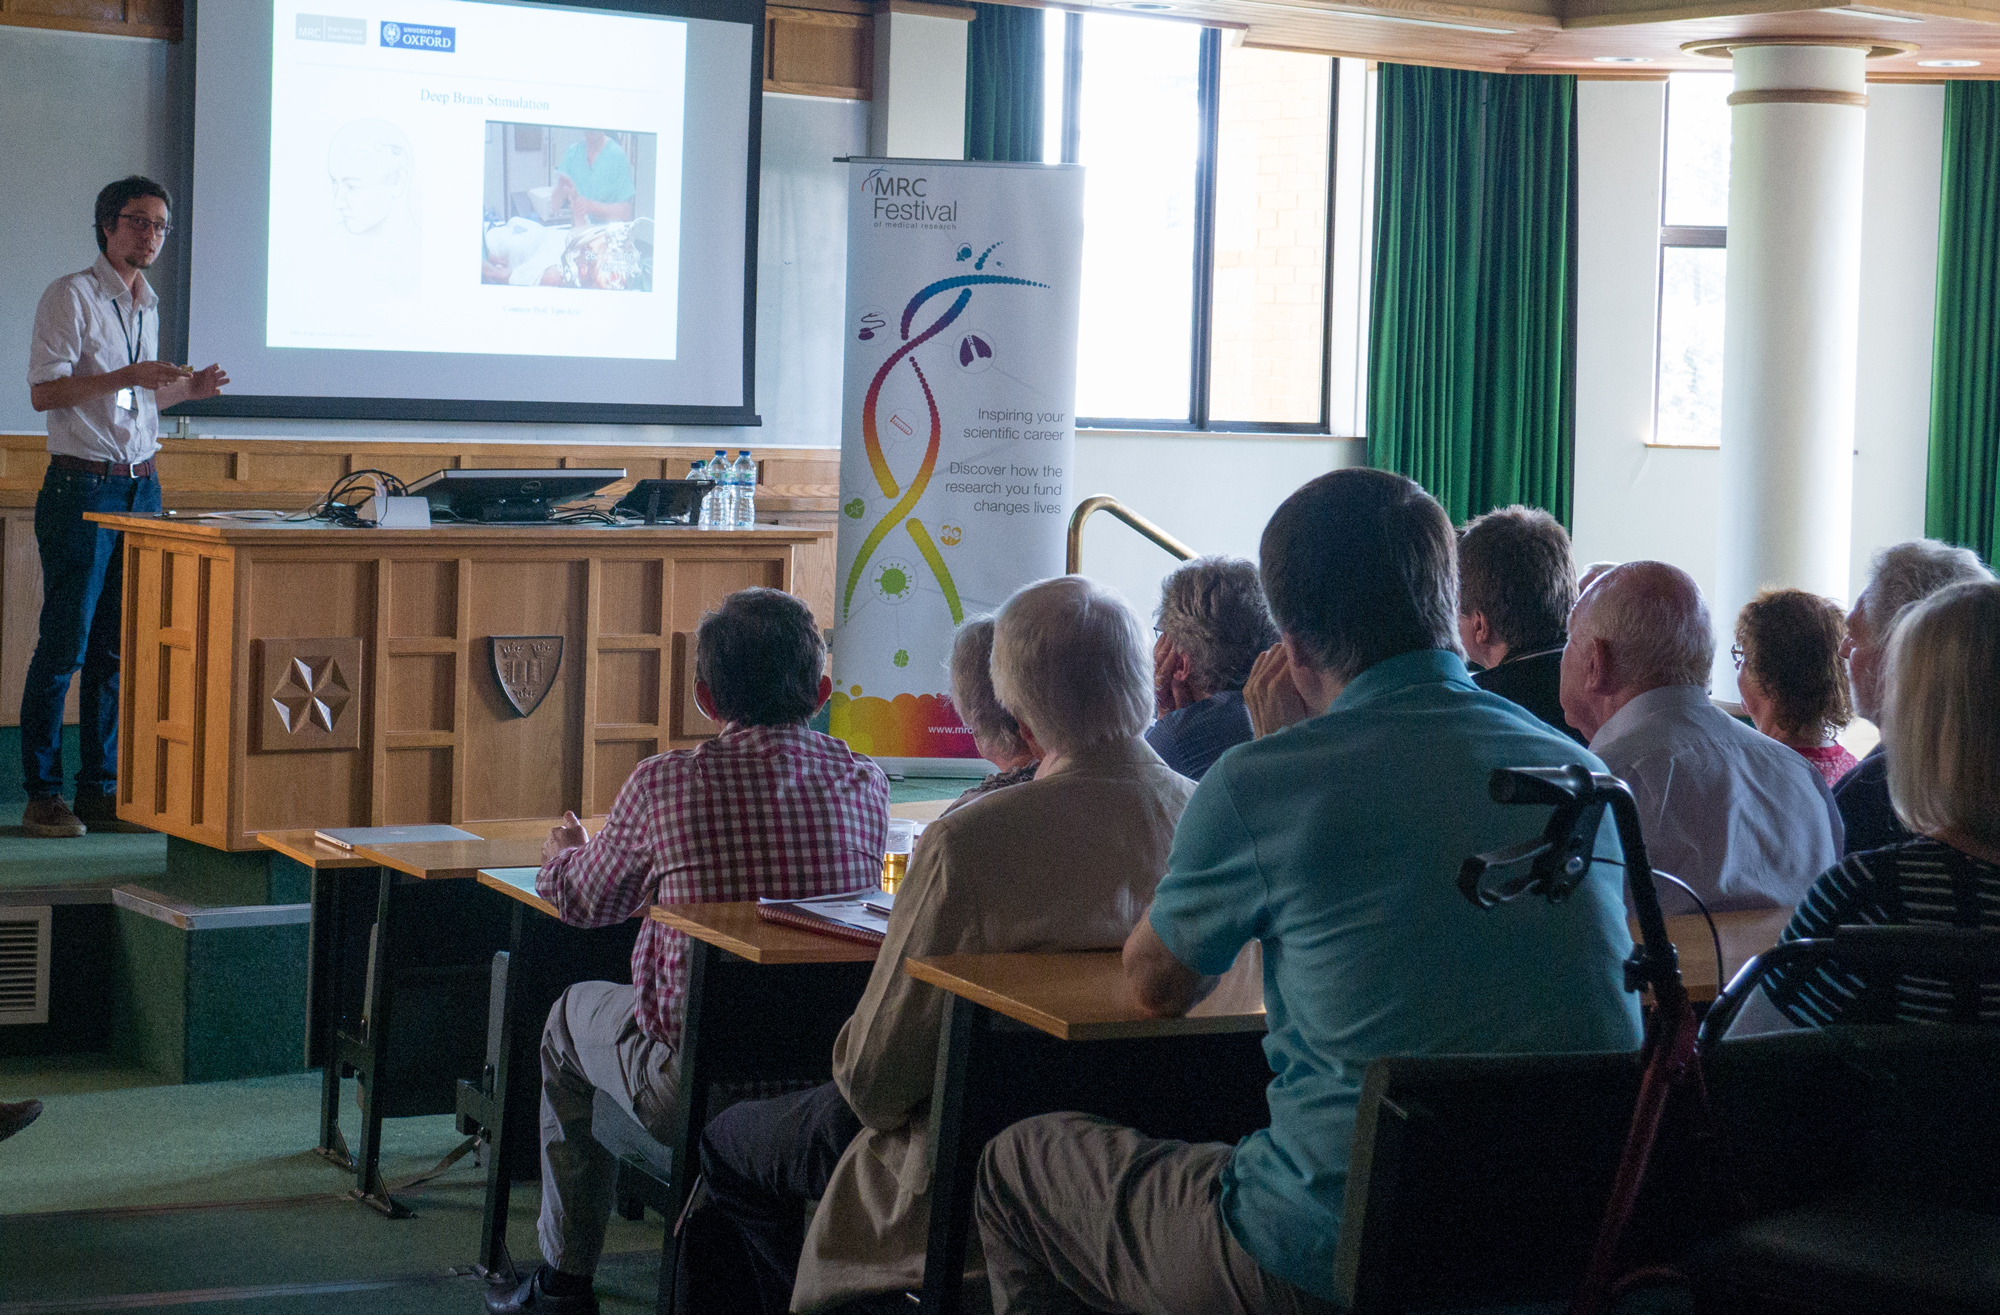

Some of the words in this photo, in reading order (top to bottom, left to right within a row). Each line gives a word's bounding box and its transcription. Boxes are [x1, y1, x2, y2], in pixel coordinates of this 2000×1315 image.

[403, 27, 433, 35] UNIVERSITY
[402, 34, 452, 48] OXFORD
[420, 88, 450, 105] Deep
[453, 91, 484, 106] Brain
[487, 94, 550, 110] Stimulation
[875, 177, 927, 197] MRC
[874, 197, 957, 222] Festival
[978, 408, 1033, 425] Inspiring
[1036, 412, 1066, 425] your
[963, 426, 1020, 440] scientific
[1023, 430, 1065, 441] career
[949, 461, 1007, 476] Discover
[1010, 464, 1039, 477] how
[1043, 465, 1063, 478] the
[945, 482, 1001, 494] research
[1005, 485, 1030, 497] you
[1034, 483, 1062, 495] fund
[973, 500, 1030, 515] changes
[1034, 501, 1062, 514] lives
